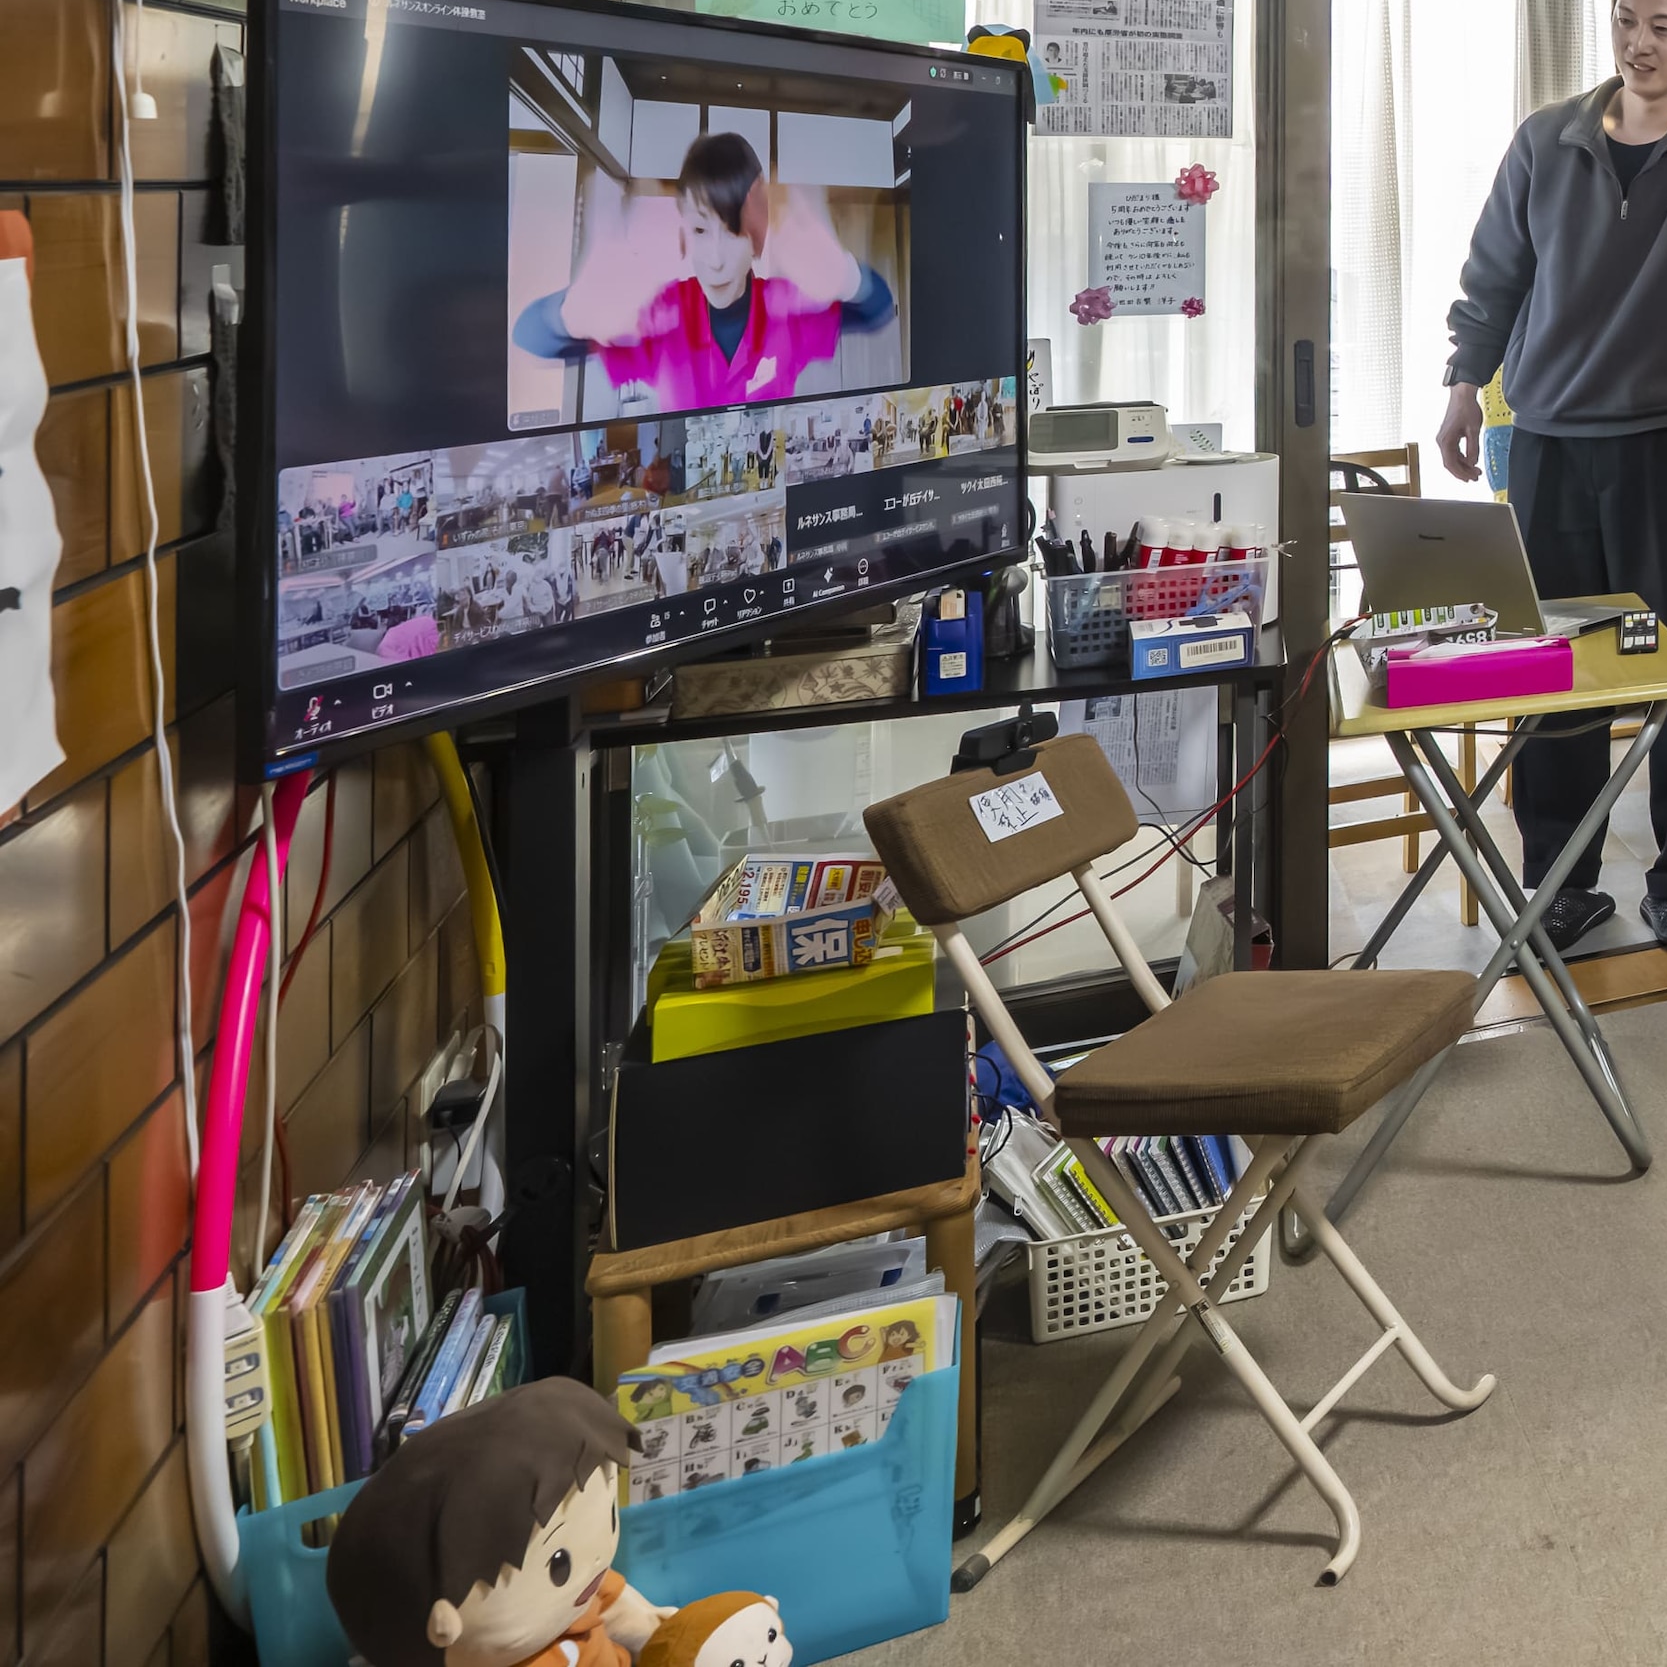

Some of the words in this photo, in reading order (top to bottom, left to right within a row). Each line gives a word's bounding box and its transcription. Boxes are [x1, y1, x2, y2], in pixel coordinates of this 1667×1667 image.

[294, 719, 332, 740] オーディオ
[371, 704, 395, 720] ビデオ
[791, 918, 848, 970] 保
[767, 1325, 876, 1383] ABC
